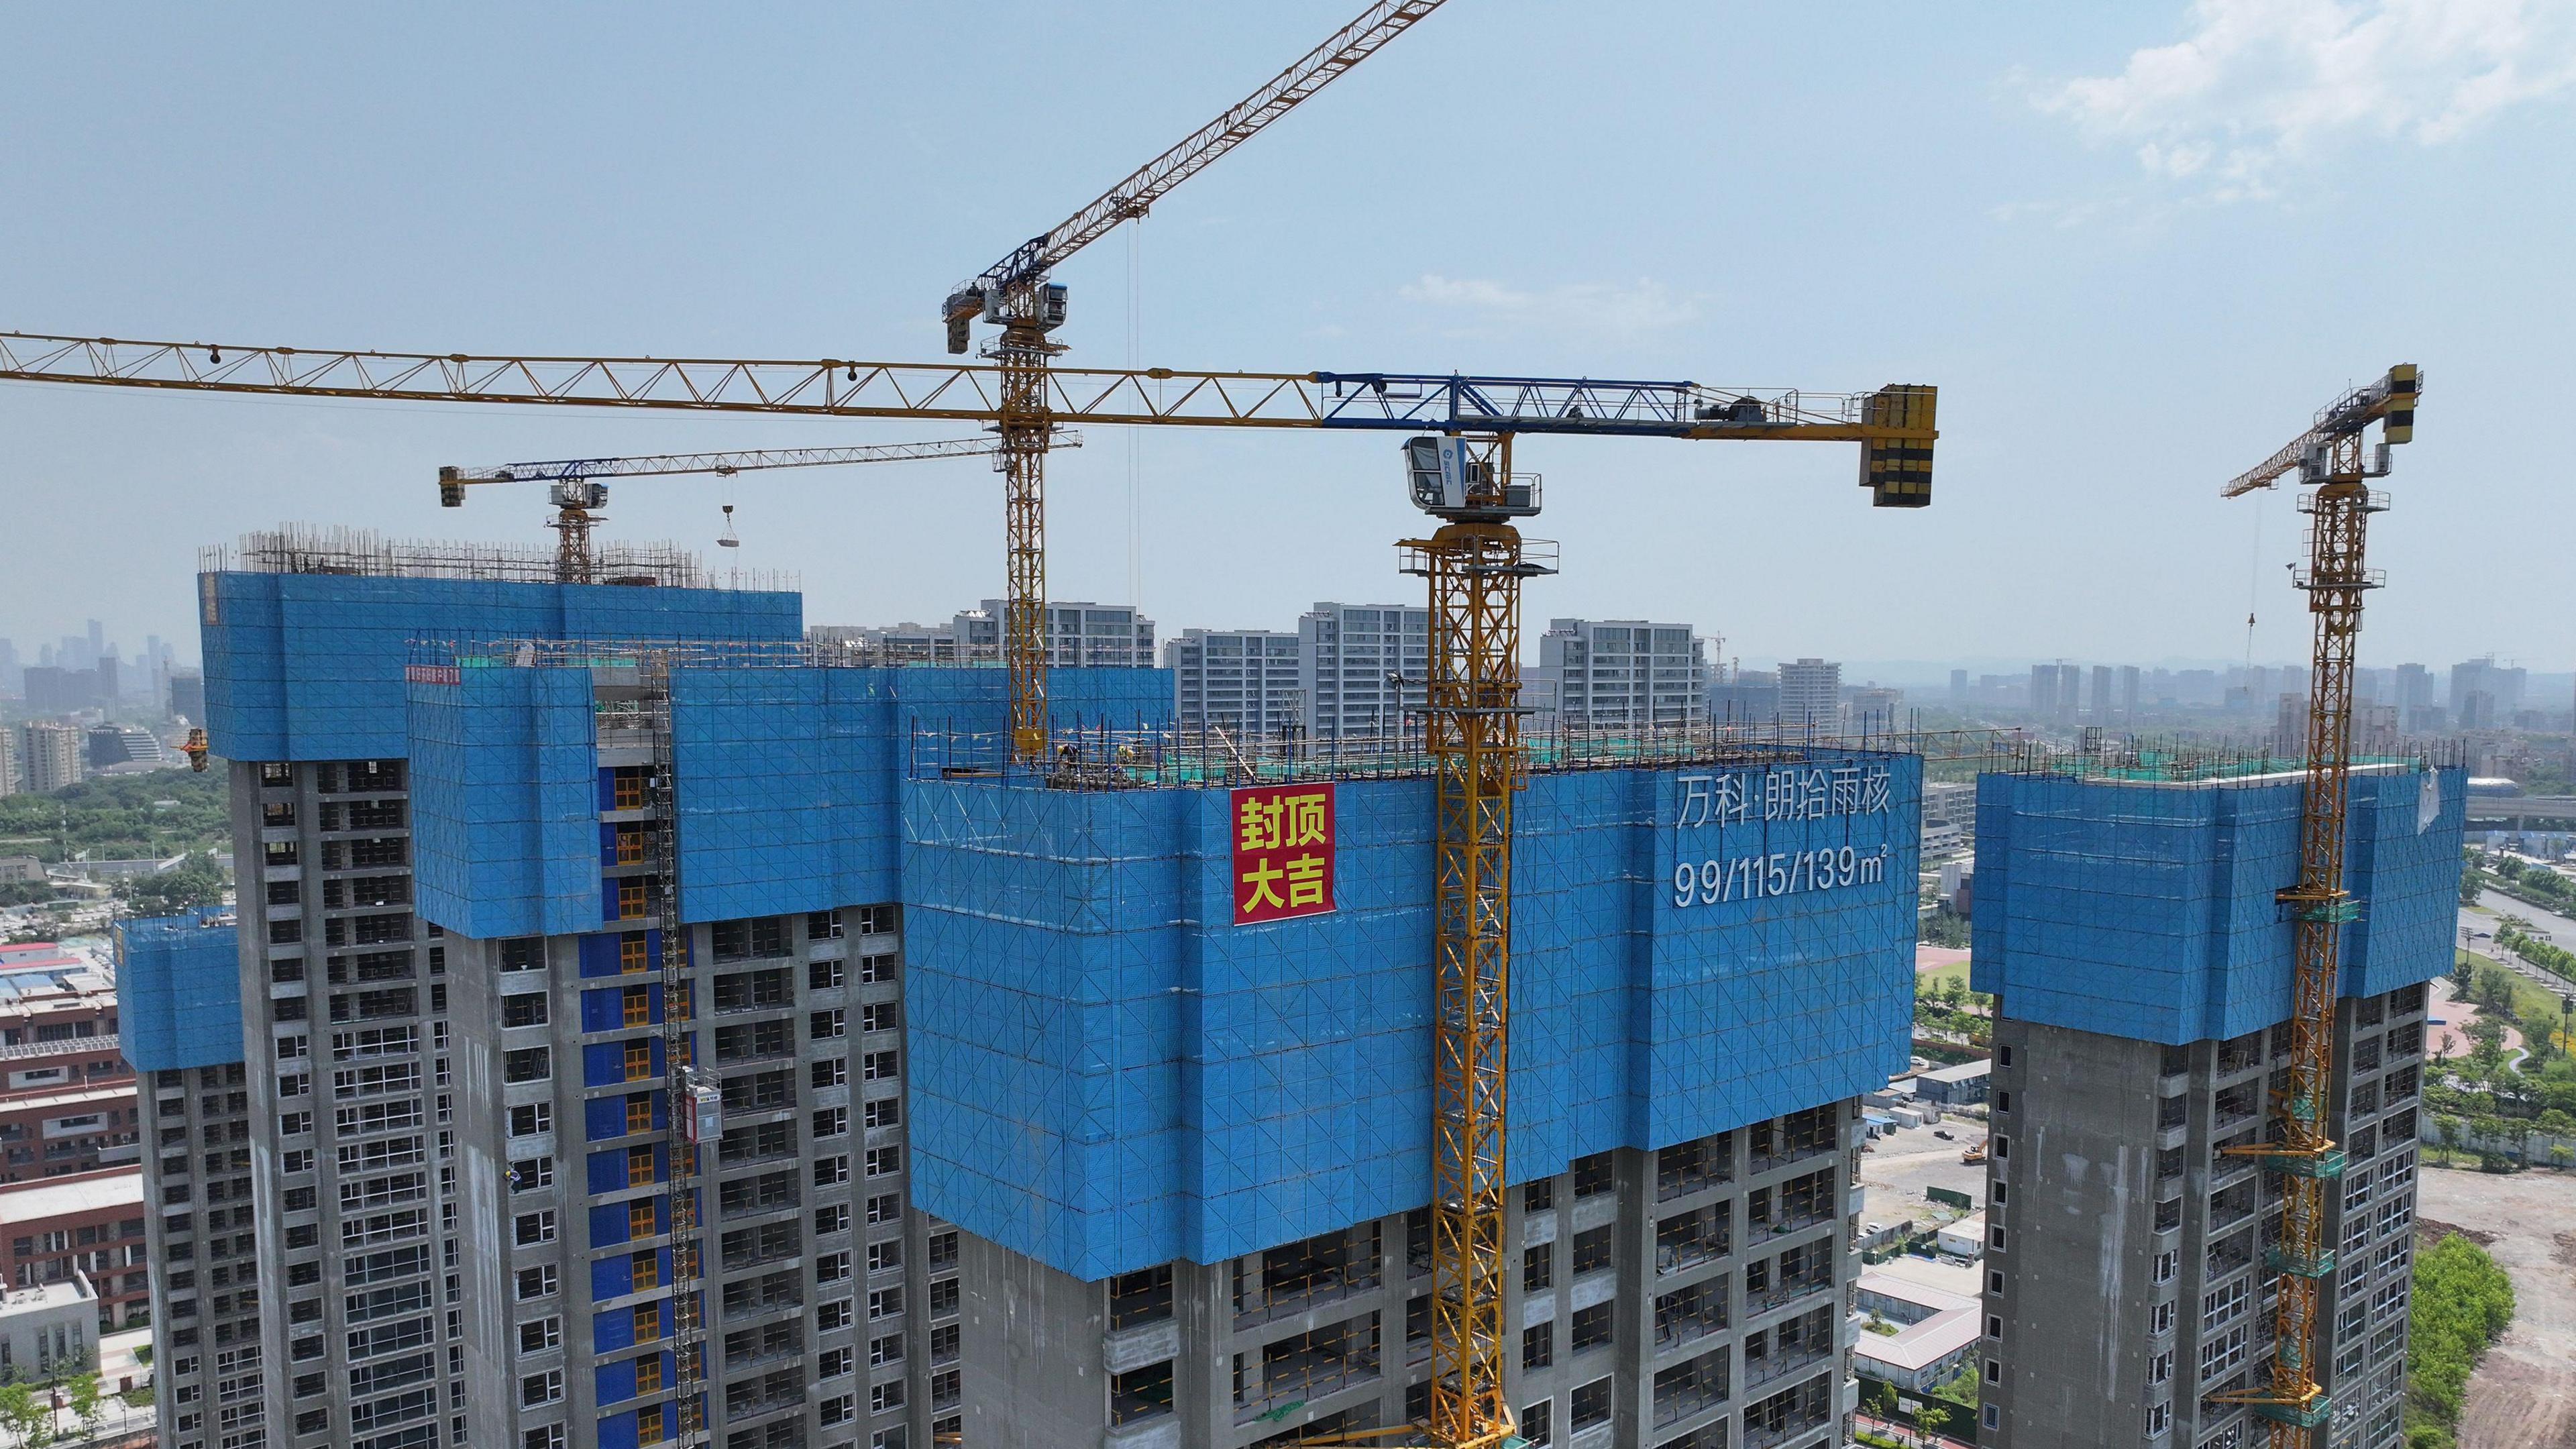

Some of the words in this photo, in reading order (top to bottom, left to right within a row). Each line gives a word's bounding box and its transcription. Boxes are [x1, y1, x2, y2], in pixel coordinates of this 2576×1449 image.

[1241, 794, 1326, 851] 封顶
[1678, 765, 1890, 829] 万科·朗拾雨核
[1242, 853, 1325, 913] 大吉
